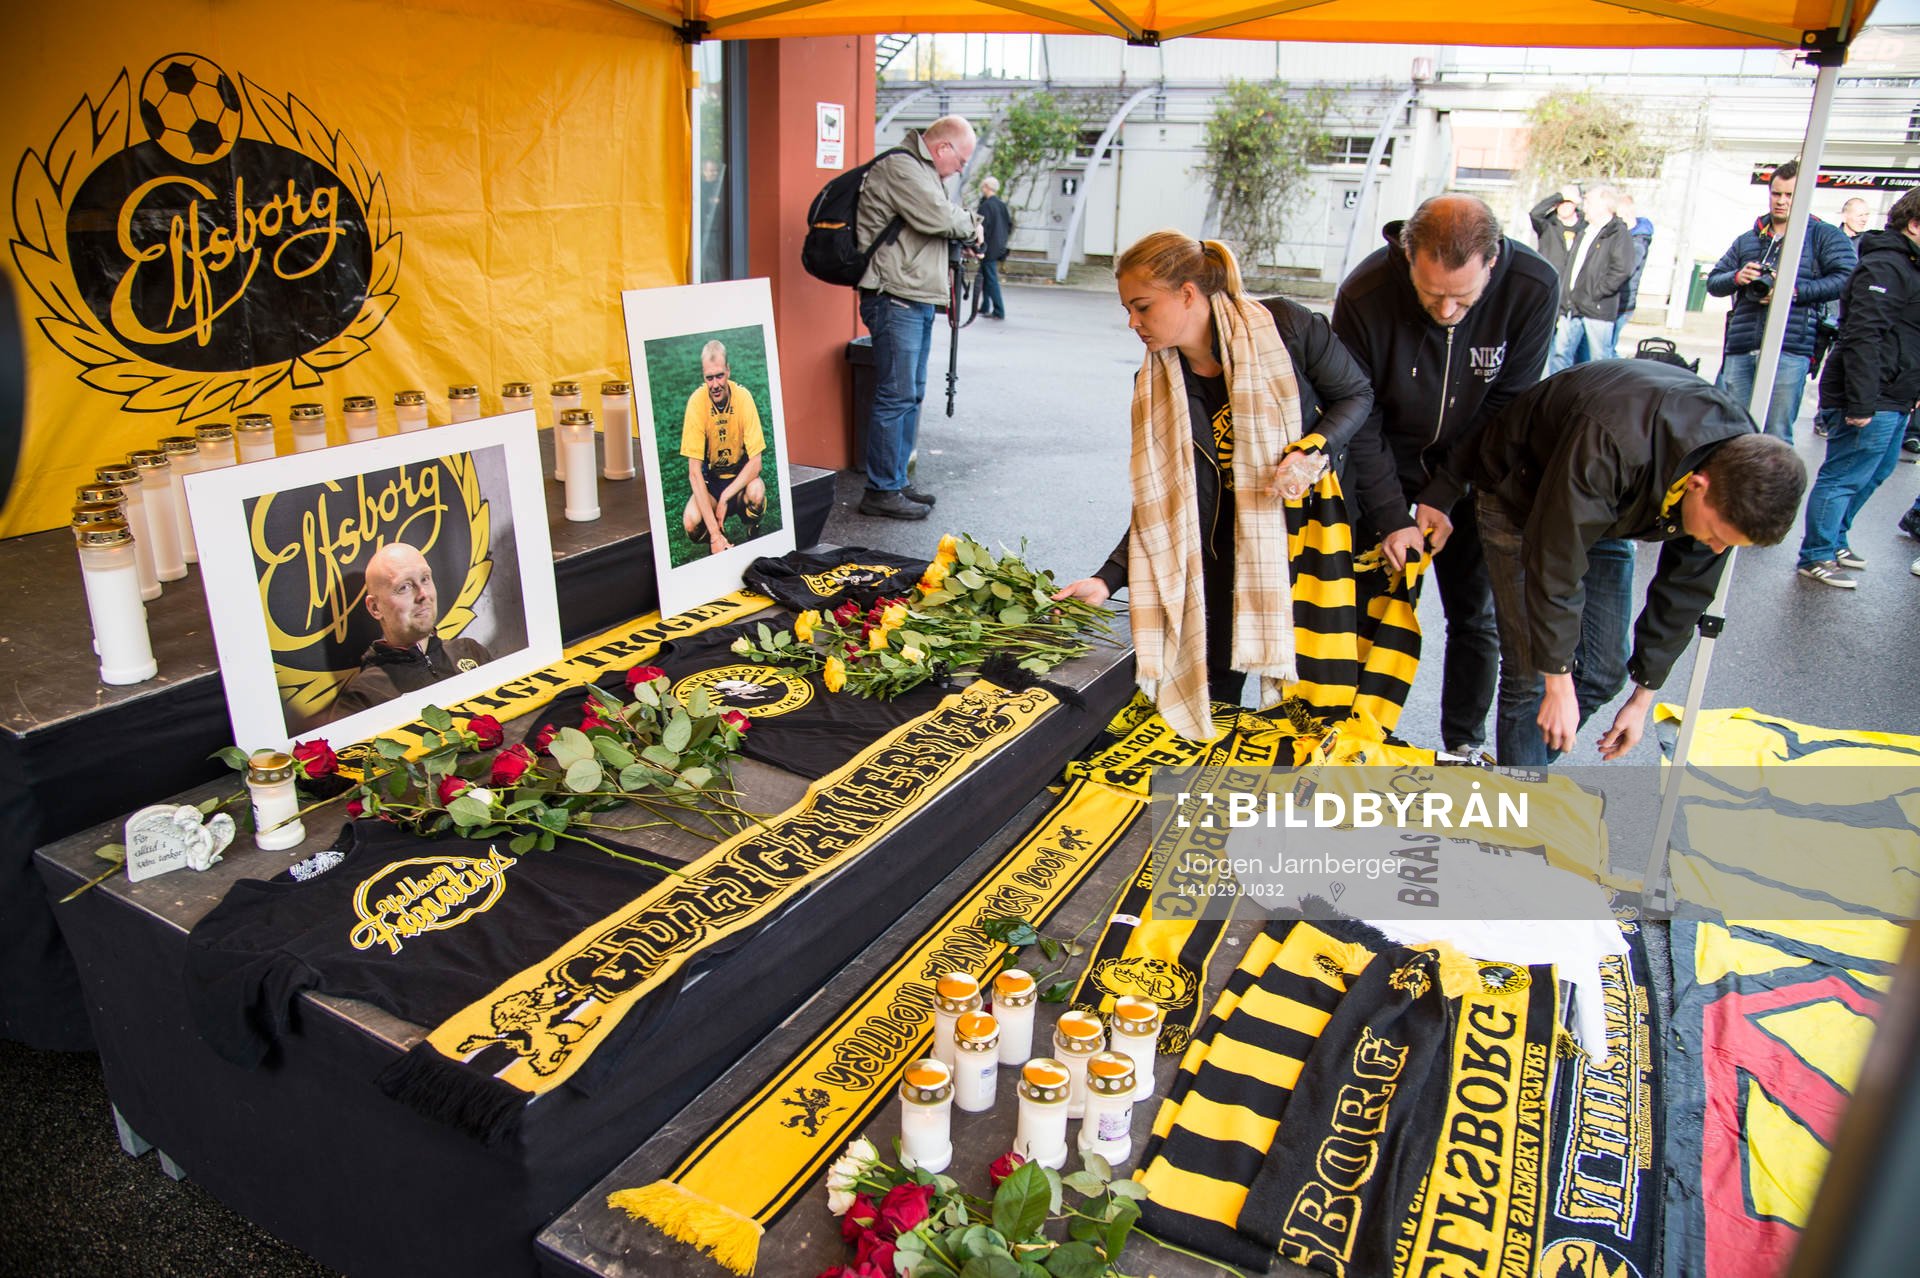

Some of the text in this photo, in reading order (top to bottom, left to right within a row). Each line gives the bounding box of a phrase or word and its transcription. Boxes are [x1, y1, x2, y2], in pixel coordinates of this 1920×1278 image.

[111, 176, 346, 347] Elfsborg
[1470, 346, 1506, 367] NIK
[246, 464, 449, 652] Elfsborg
[566, 597, 741, 668] TROGEN
[1011, 847, 1070, 890] 2001
